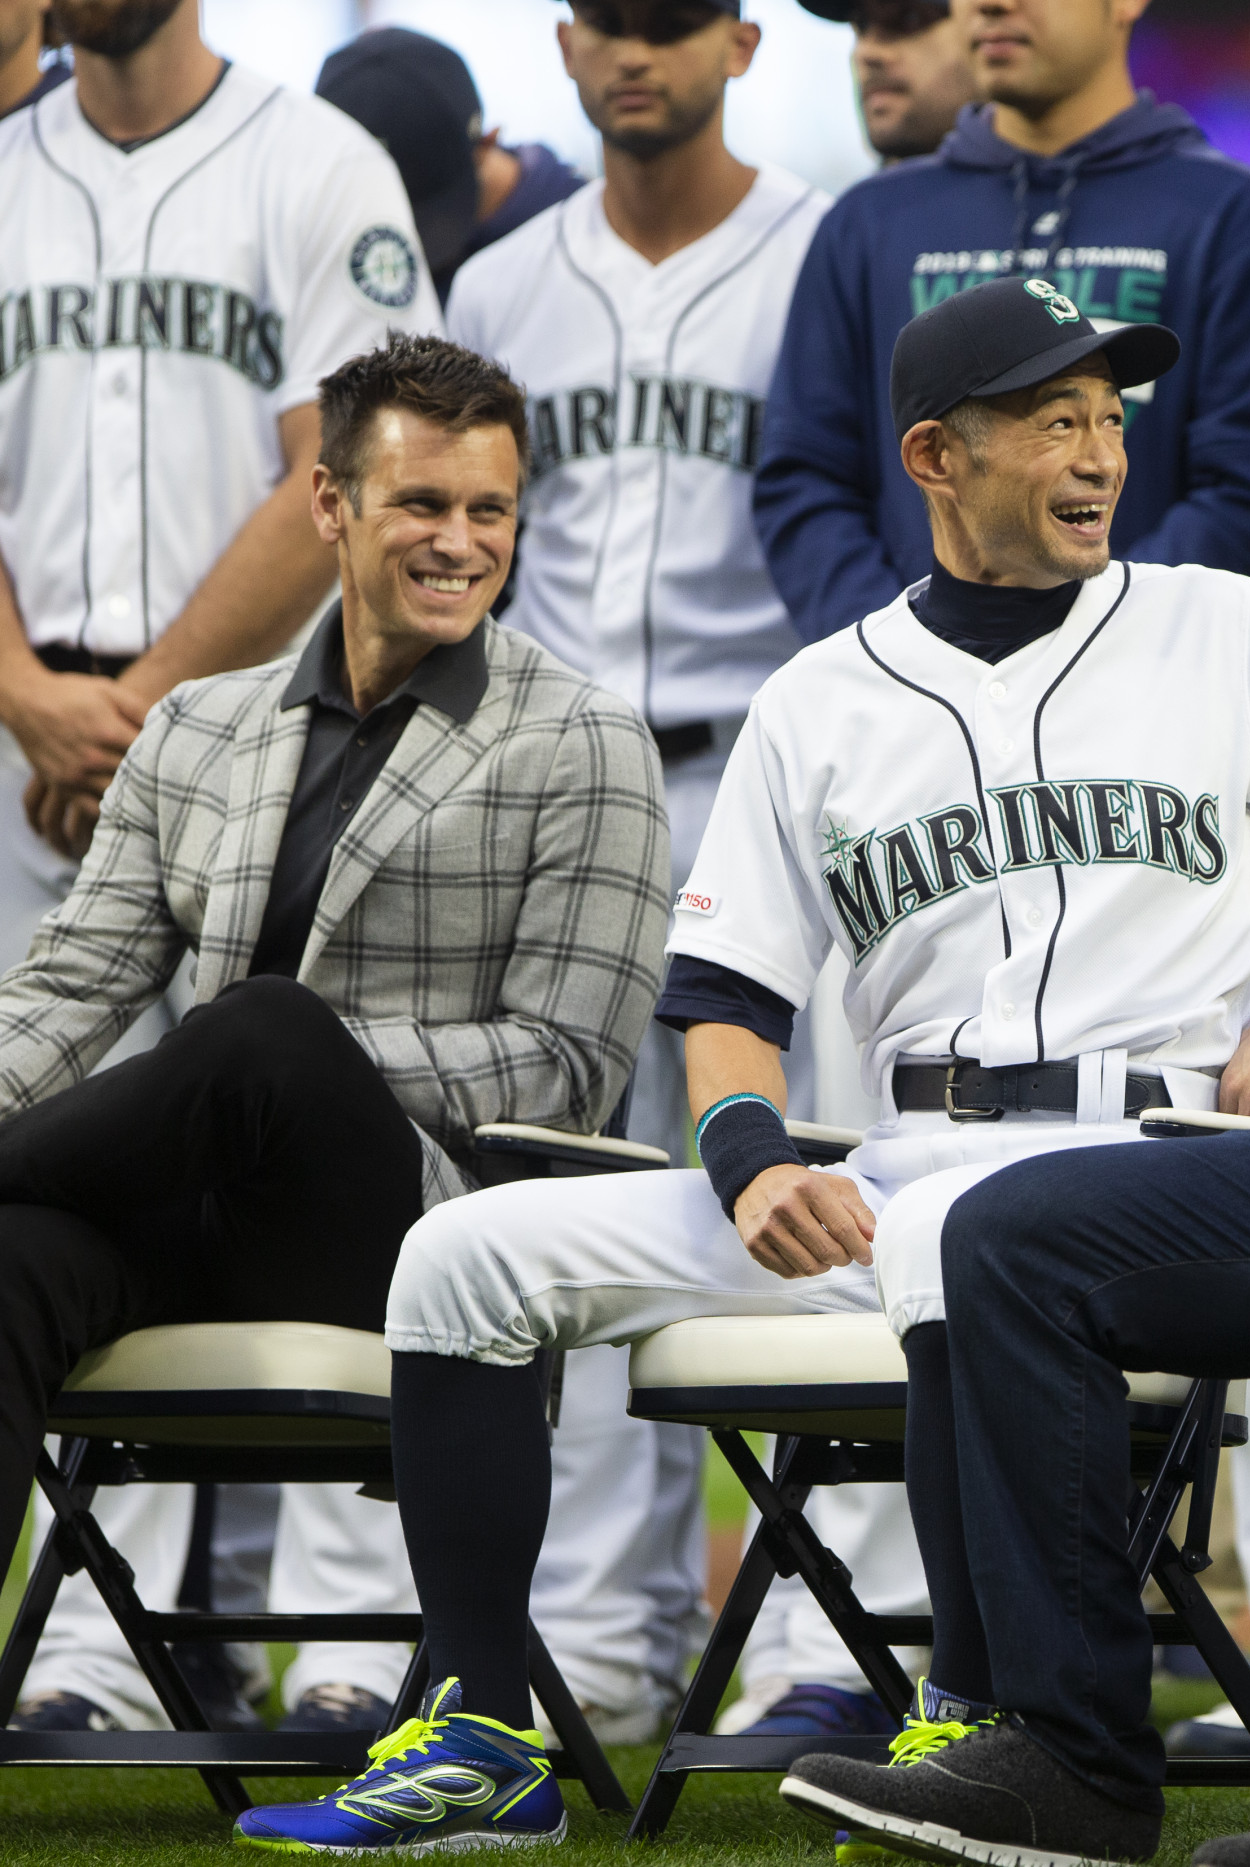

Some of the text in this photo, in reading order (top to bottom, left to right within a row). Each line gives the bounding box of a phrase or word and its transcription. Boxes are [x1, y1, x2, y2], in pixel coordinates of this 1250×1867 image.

[0, 274, 285, 391] ARINERS
[526, 371, 764, 479] ARINE
[822, 778, 1228, 968] MARINERS
